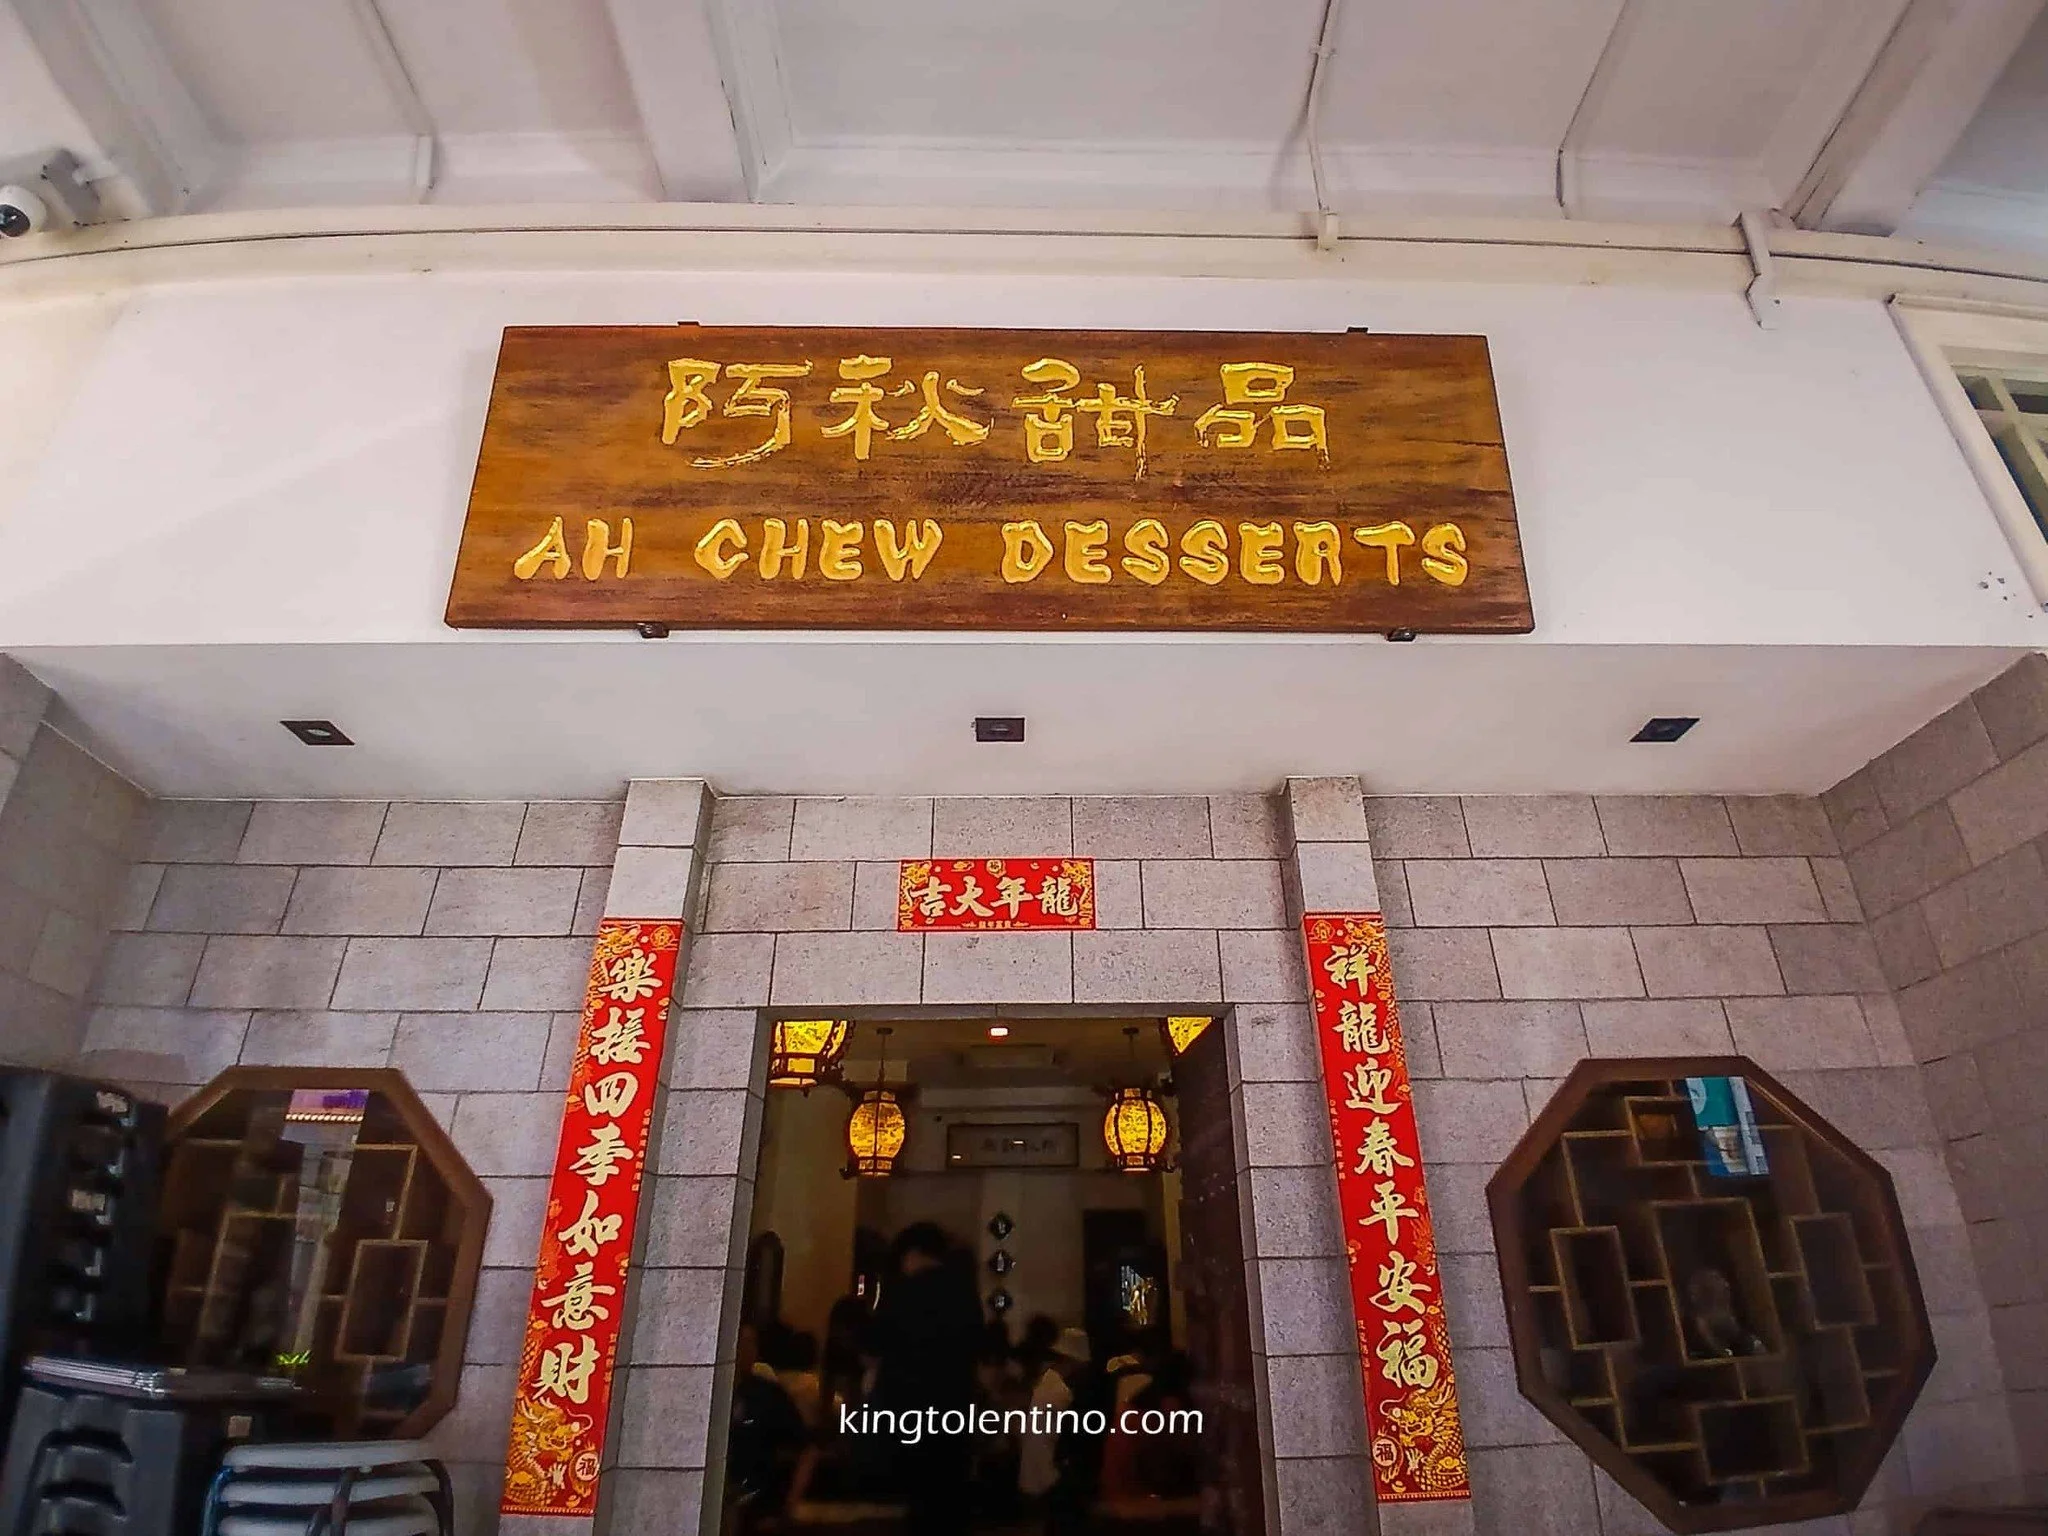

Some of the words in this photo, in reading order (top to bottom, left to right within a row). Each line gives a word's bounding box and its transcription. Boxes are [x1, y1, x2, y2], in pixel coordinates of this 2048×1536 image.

[660, 354, 1332, 481] 阿秋甜品
[513, 515, 634, 581] AH
[693, 517, 944, 582] CHEW
[1000, 519, 1469, 586] DESSERTS
[1322, 944, 1439, 1389] 祥龍迎春平安福
